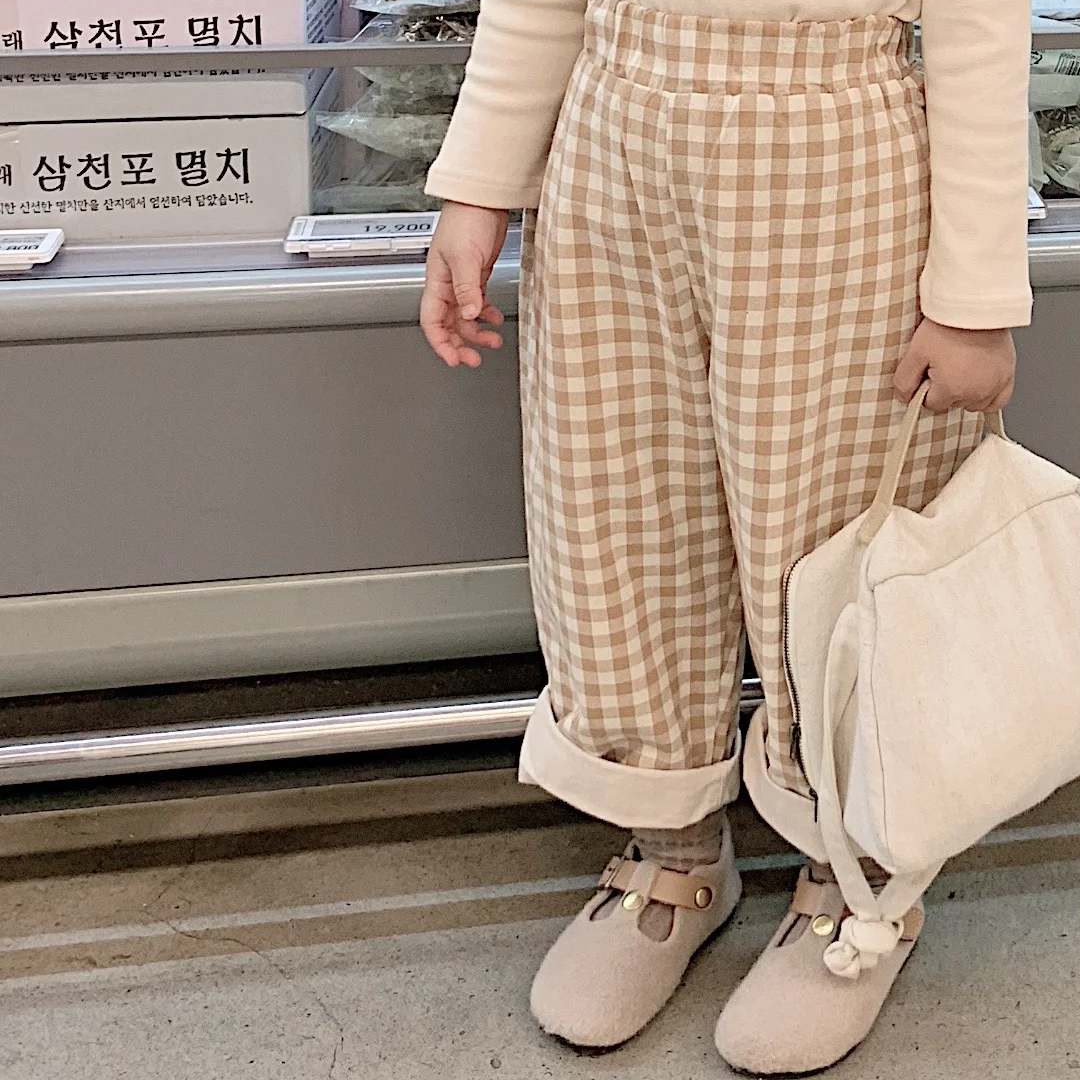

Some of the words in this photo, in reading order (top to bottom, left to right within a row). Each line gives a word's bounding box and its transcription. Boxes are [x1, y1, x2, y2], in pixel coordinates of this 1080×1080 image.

[33, 152, 157, 192] 삼천포
[175, 147, 250, 187] 멸치
[19, 200, 53, 214] 신선한
[55, 199, 99, 213] 멸치만을
[103, 196, 146, 211] 산지에서
[195, 192, 253, 207] 담았습니다.
[364, 223, 431, 233] 19,900
